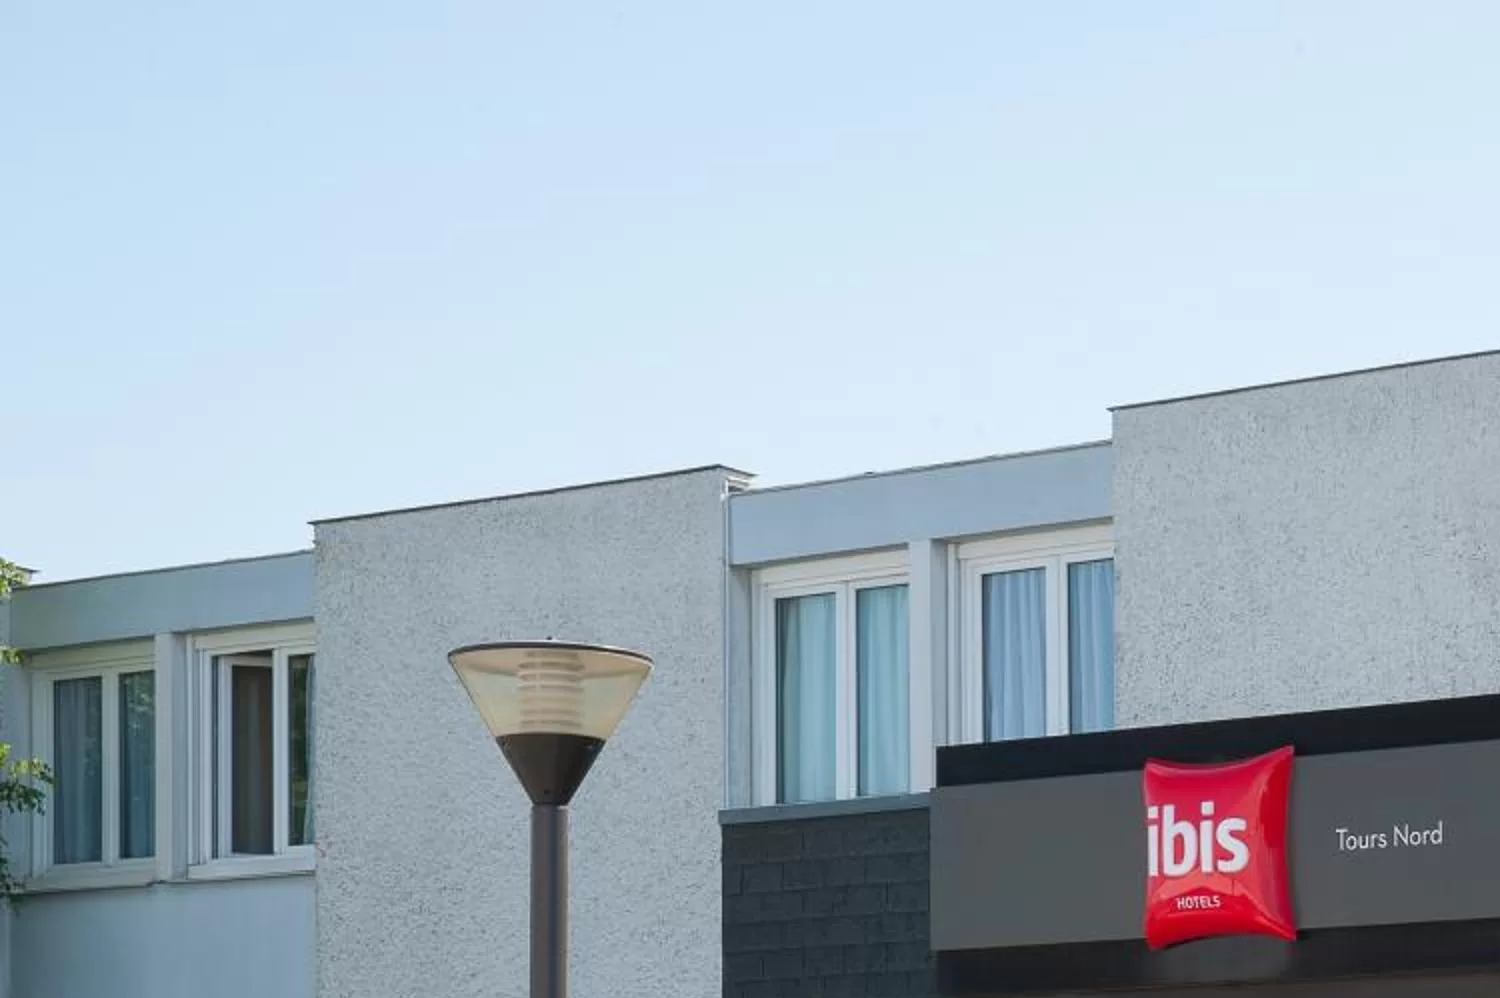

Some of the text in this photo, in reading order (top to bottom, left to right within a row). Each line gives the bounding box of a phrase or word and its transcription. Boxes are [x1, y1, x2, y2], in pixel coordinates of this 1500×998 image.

[1147, 800, 1250, 877] ibis
[1335, 819, 1443, 851] Tours Nord
[1176, 895, 1221, 909] HOTELS
